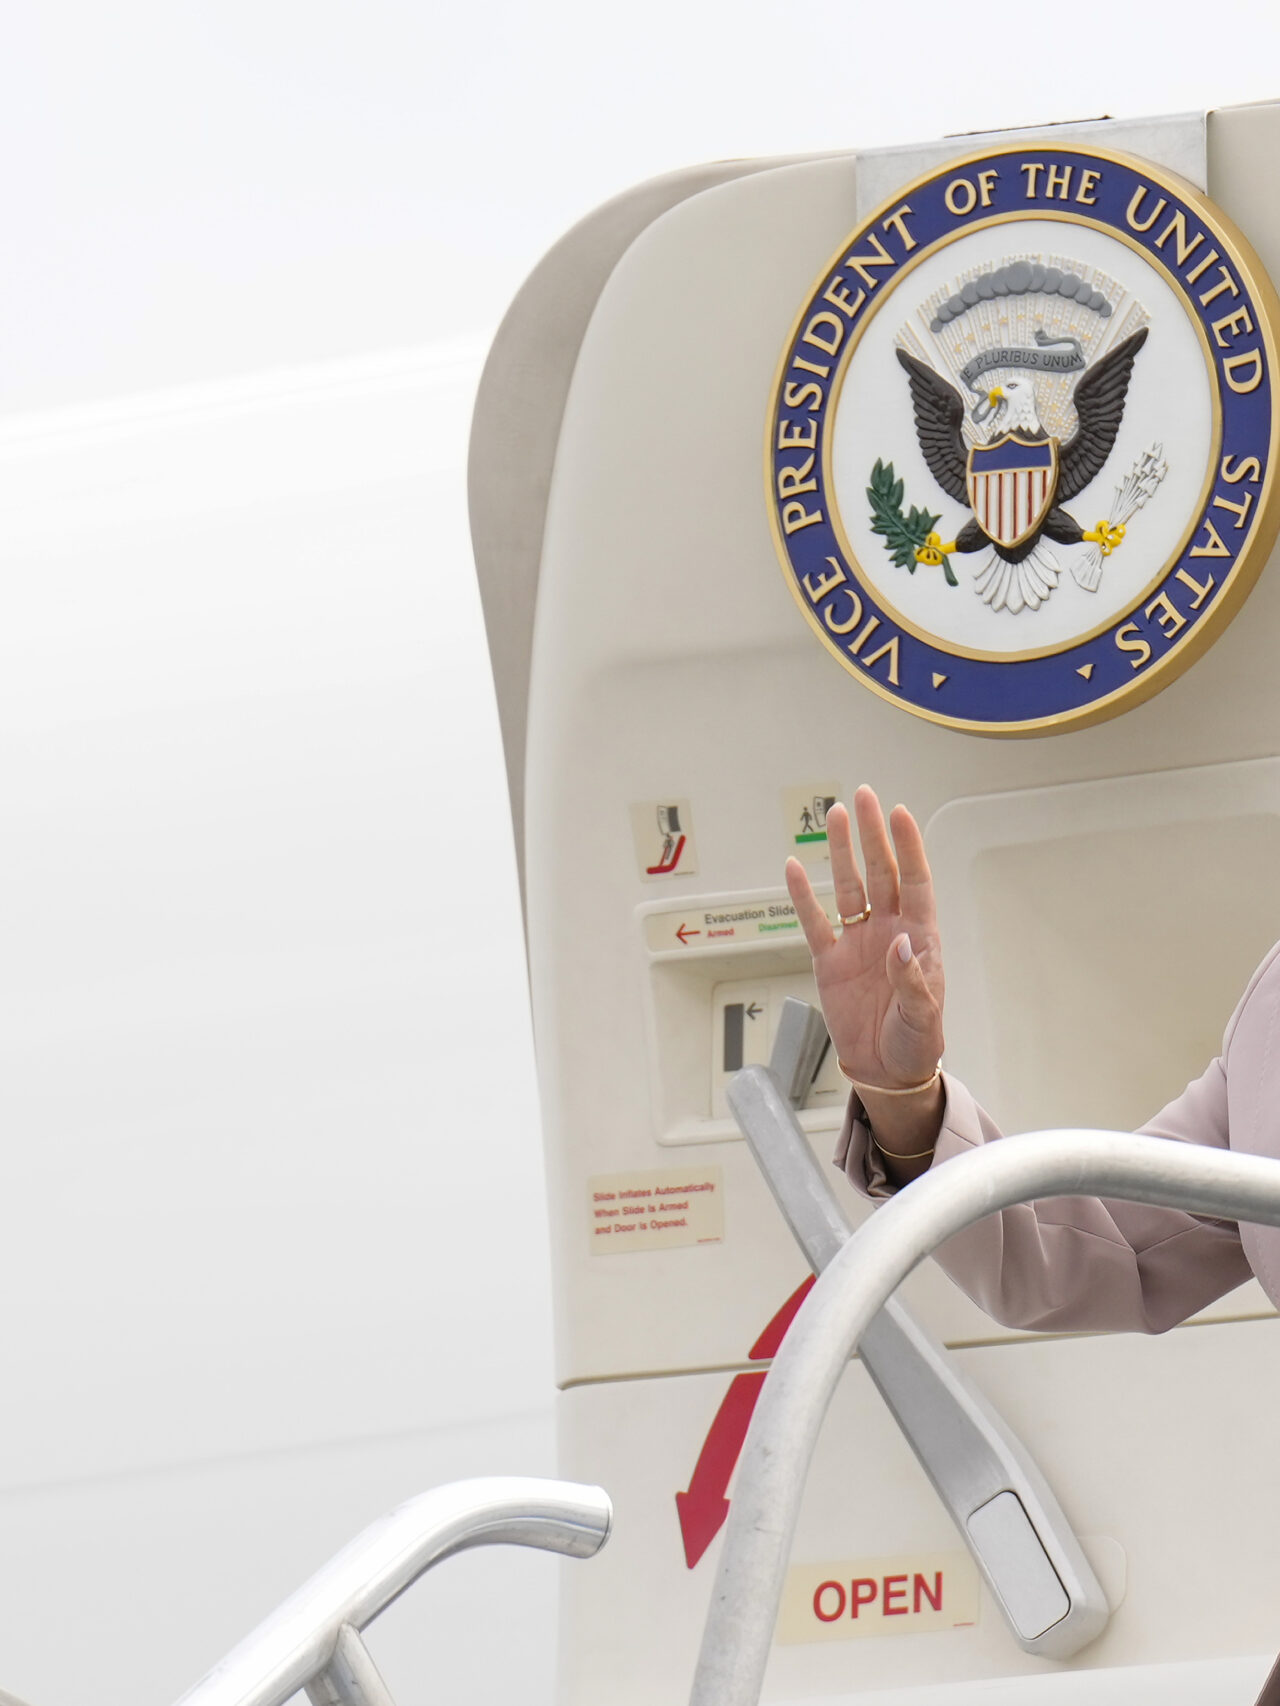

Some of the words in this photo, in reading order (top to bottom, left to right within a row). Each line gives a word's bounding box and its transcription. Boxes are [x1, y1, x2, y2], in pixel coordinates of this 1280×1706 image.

[944, 168, 999, 216] OF
[1020, 162, 1102, 204] THE
[1125, 185, 1264, 395] UNITED
[778, 205, 917, 535] PRESIDENT
[975, 350, 1039, 369] PLURIBUS
[1043, 353, 1082, 368] UNUM
[1114, 454, 1261, 669] STATES
[804, 557, 902, 687] VICE
[705, 908, 765, 925] Evacuation
[768, 905, 796, 915] Slide
[707, 928, 735, 938] Armed
[593, 1192, 616, 1202] Slide
[619, 1189, 652, 1199] Inflates
[655, 1182, 714, 1195] Automatically
[594, 1209, 620, 1218] When
[622, 1206, 645, 1216] Slide
[659, 1201, 689, 1211] Armed
[595, 1225, 612, 1235] and
[614, 1223, 636, 1233] Door
[813, 1571, 943, 1622] OPEN
